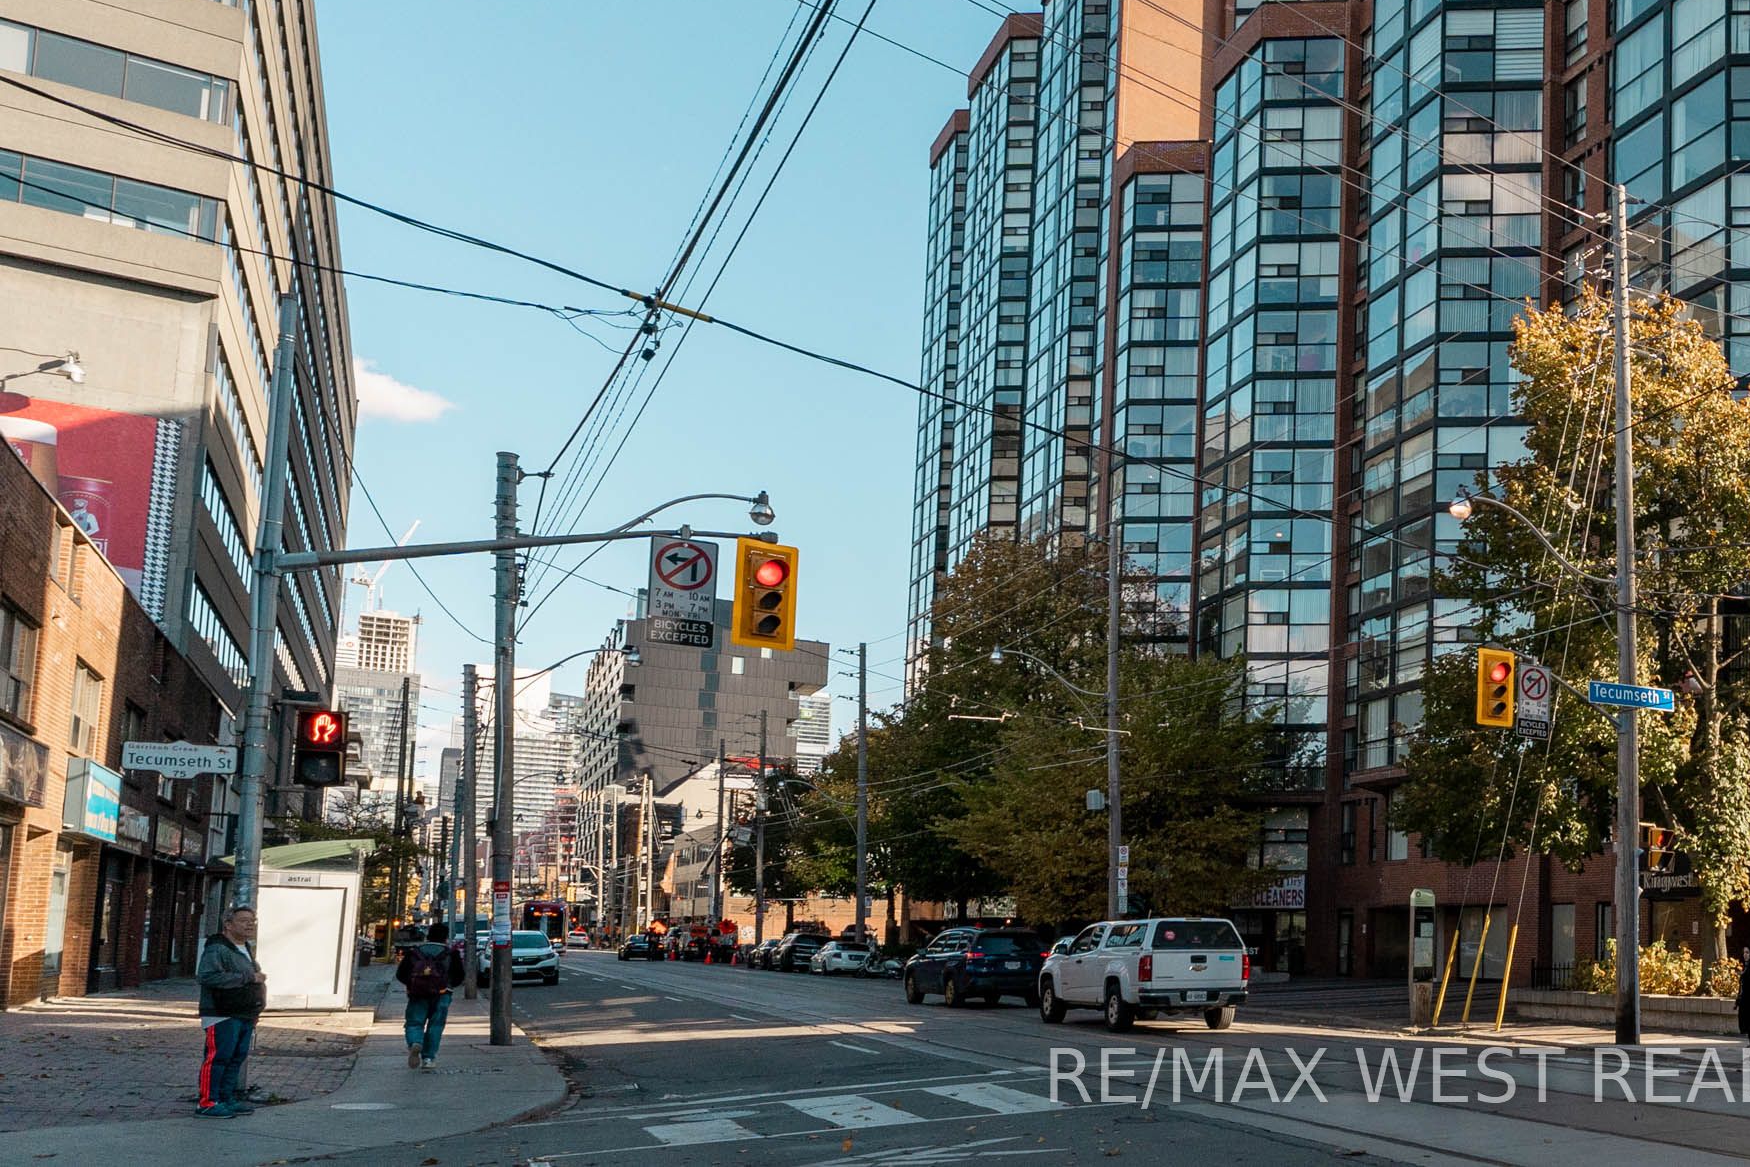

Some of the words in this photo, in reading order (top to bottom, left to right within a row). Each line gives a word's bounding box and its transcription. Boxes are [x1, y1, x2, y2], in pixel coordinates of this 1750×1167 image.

[655, 587, 661, 596] 7
[688, 592, 699, 601] 10
[656, 600, 662, 608] 3
[690, 603, 696, 612] 7
[654, 619, 706, 633] BICYCLES
[650, 630, 709, 644] EXCEPTED
[1594, 683, 1660, 704] Tecumseth
[128, 752, 212, 768] Tecumseth
[218, 757, 232, 769] St
[173, 770, 187, 778] 75
[1643, 871, 1695, 892] Kingwest
[1254, 889, 1303, 906] CLEANERS
